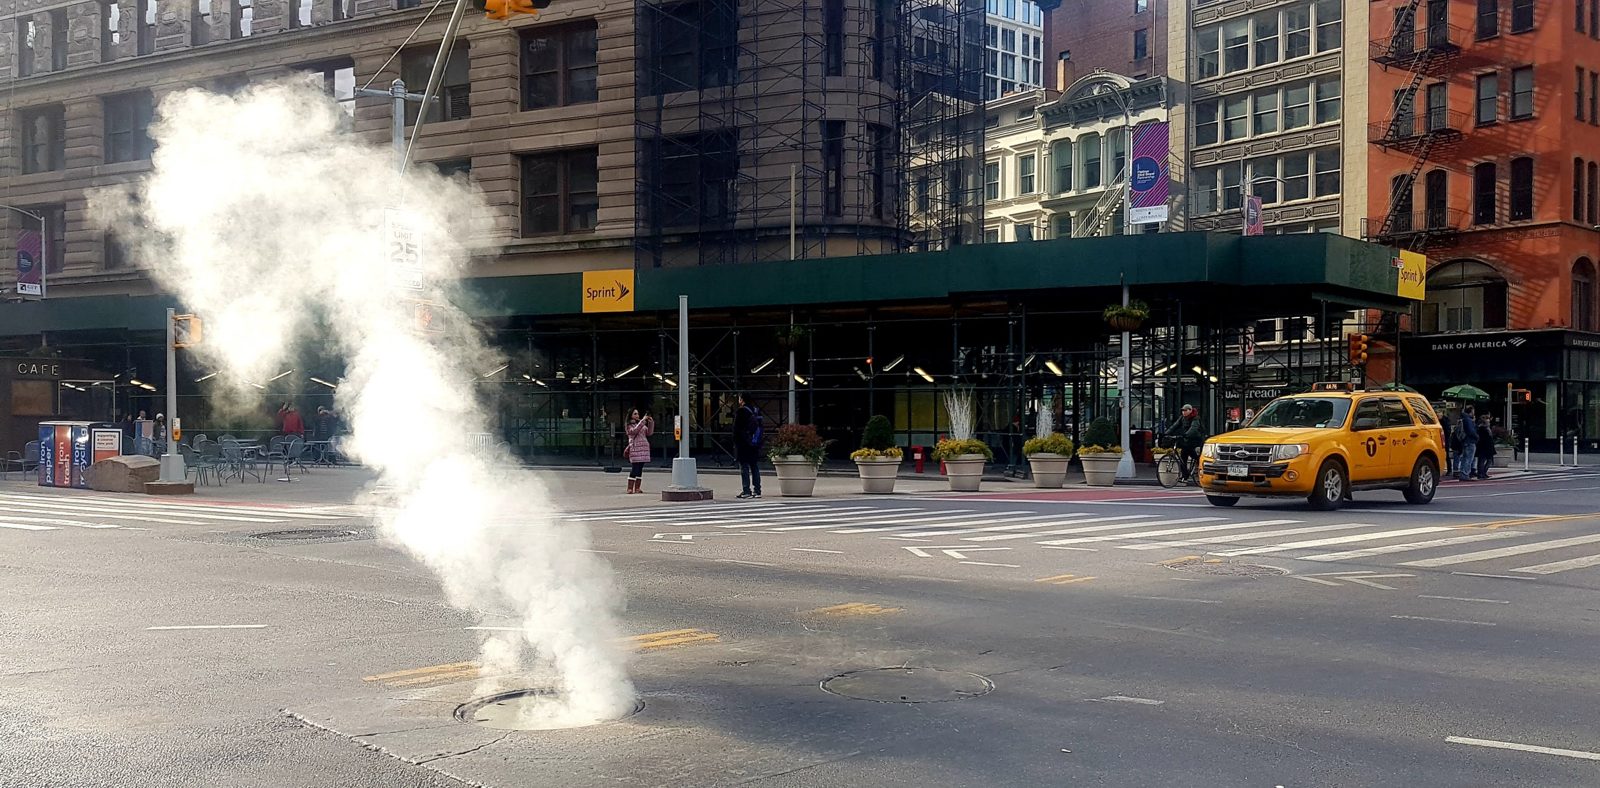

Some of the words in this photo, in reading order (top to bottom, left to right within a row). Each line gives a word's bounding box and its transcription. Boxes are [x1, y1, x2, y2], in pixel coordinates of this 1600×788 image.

[393, 231, 413, 241] LIMIT
[390, 241, 418, 264] 25
[1400, 268, 1418, 284] Sprint
[586, 286, 616, 301] Sprint
[1431, 343, 1454, 351] BANK
[1455, 342, 1467, 350] OF
[1468, 340, 1507, 349] AMERICA
[17, 363, 59, 376] CAFE
